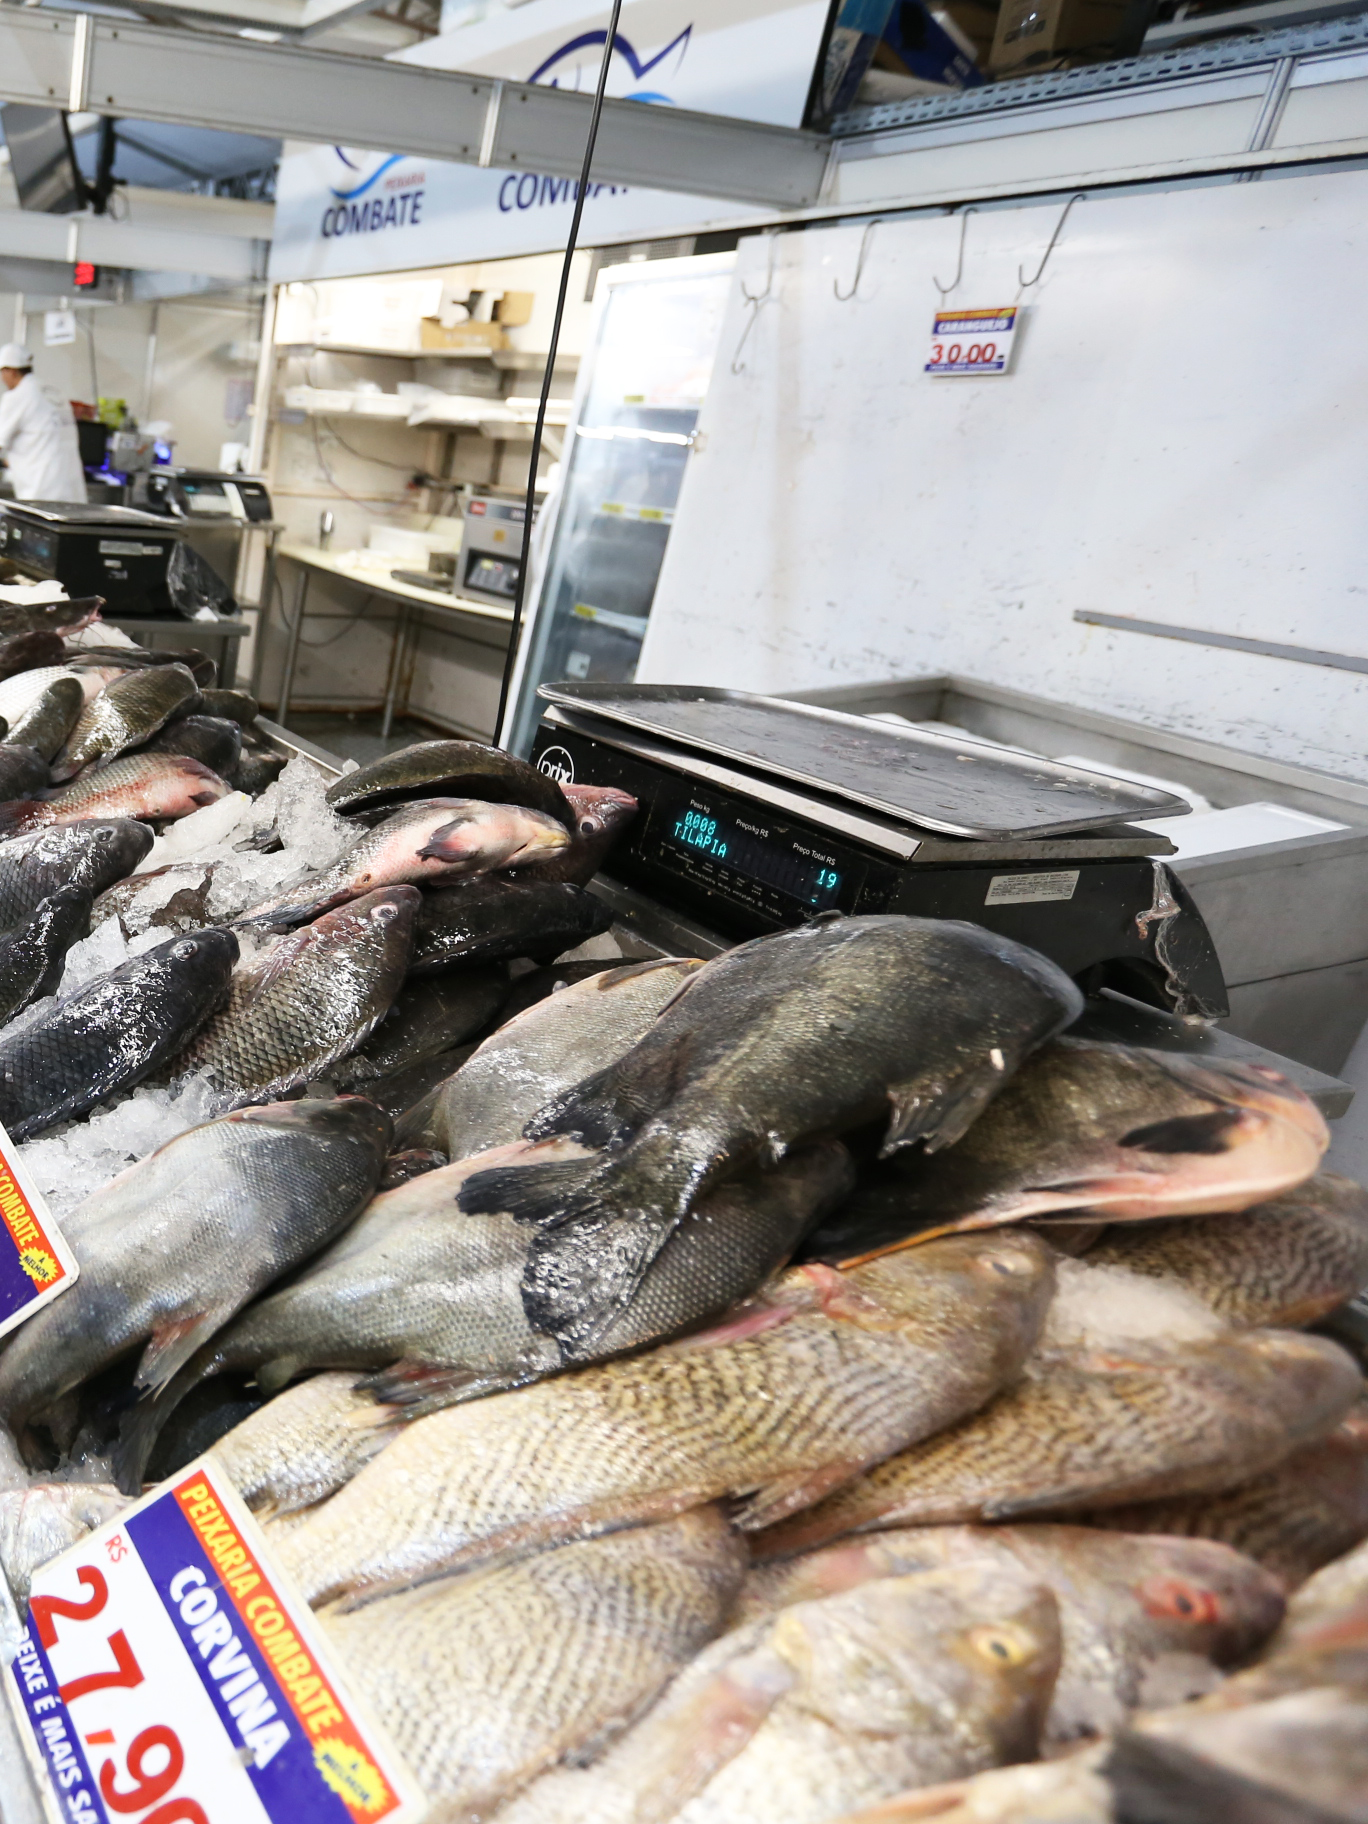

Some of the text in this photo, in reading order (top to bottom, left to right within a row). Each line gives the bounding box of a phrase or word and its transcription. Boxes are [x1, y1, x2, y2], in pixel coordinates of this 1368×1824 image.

[320, 190, 425, 239] COMBATE
[690, 798, 711, 814] Peso kg
[674, 821, 727, 858] TILAPIA
[735, 818, 760, 837] Preço/kg
[792, 842, 810, 855] Preço
[811, 849, 826, 861] Total
[816, 868, 838, 889] 19
[23, 1254, 49, 1280] A MELHOR
[104, 1534, 128, 1563] R$
[180, 1482, 344, 1735] PEIXARIA COMBATE
[169, 1565, 291, 1770] CORVINA
[33, 1694, 63, 1715] É
[40, 1716, 83, 1789] MAIS
